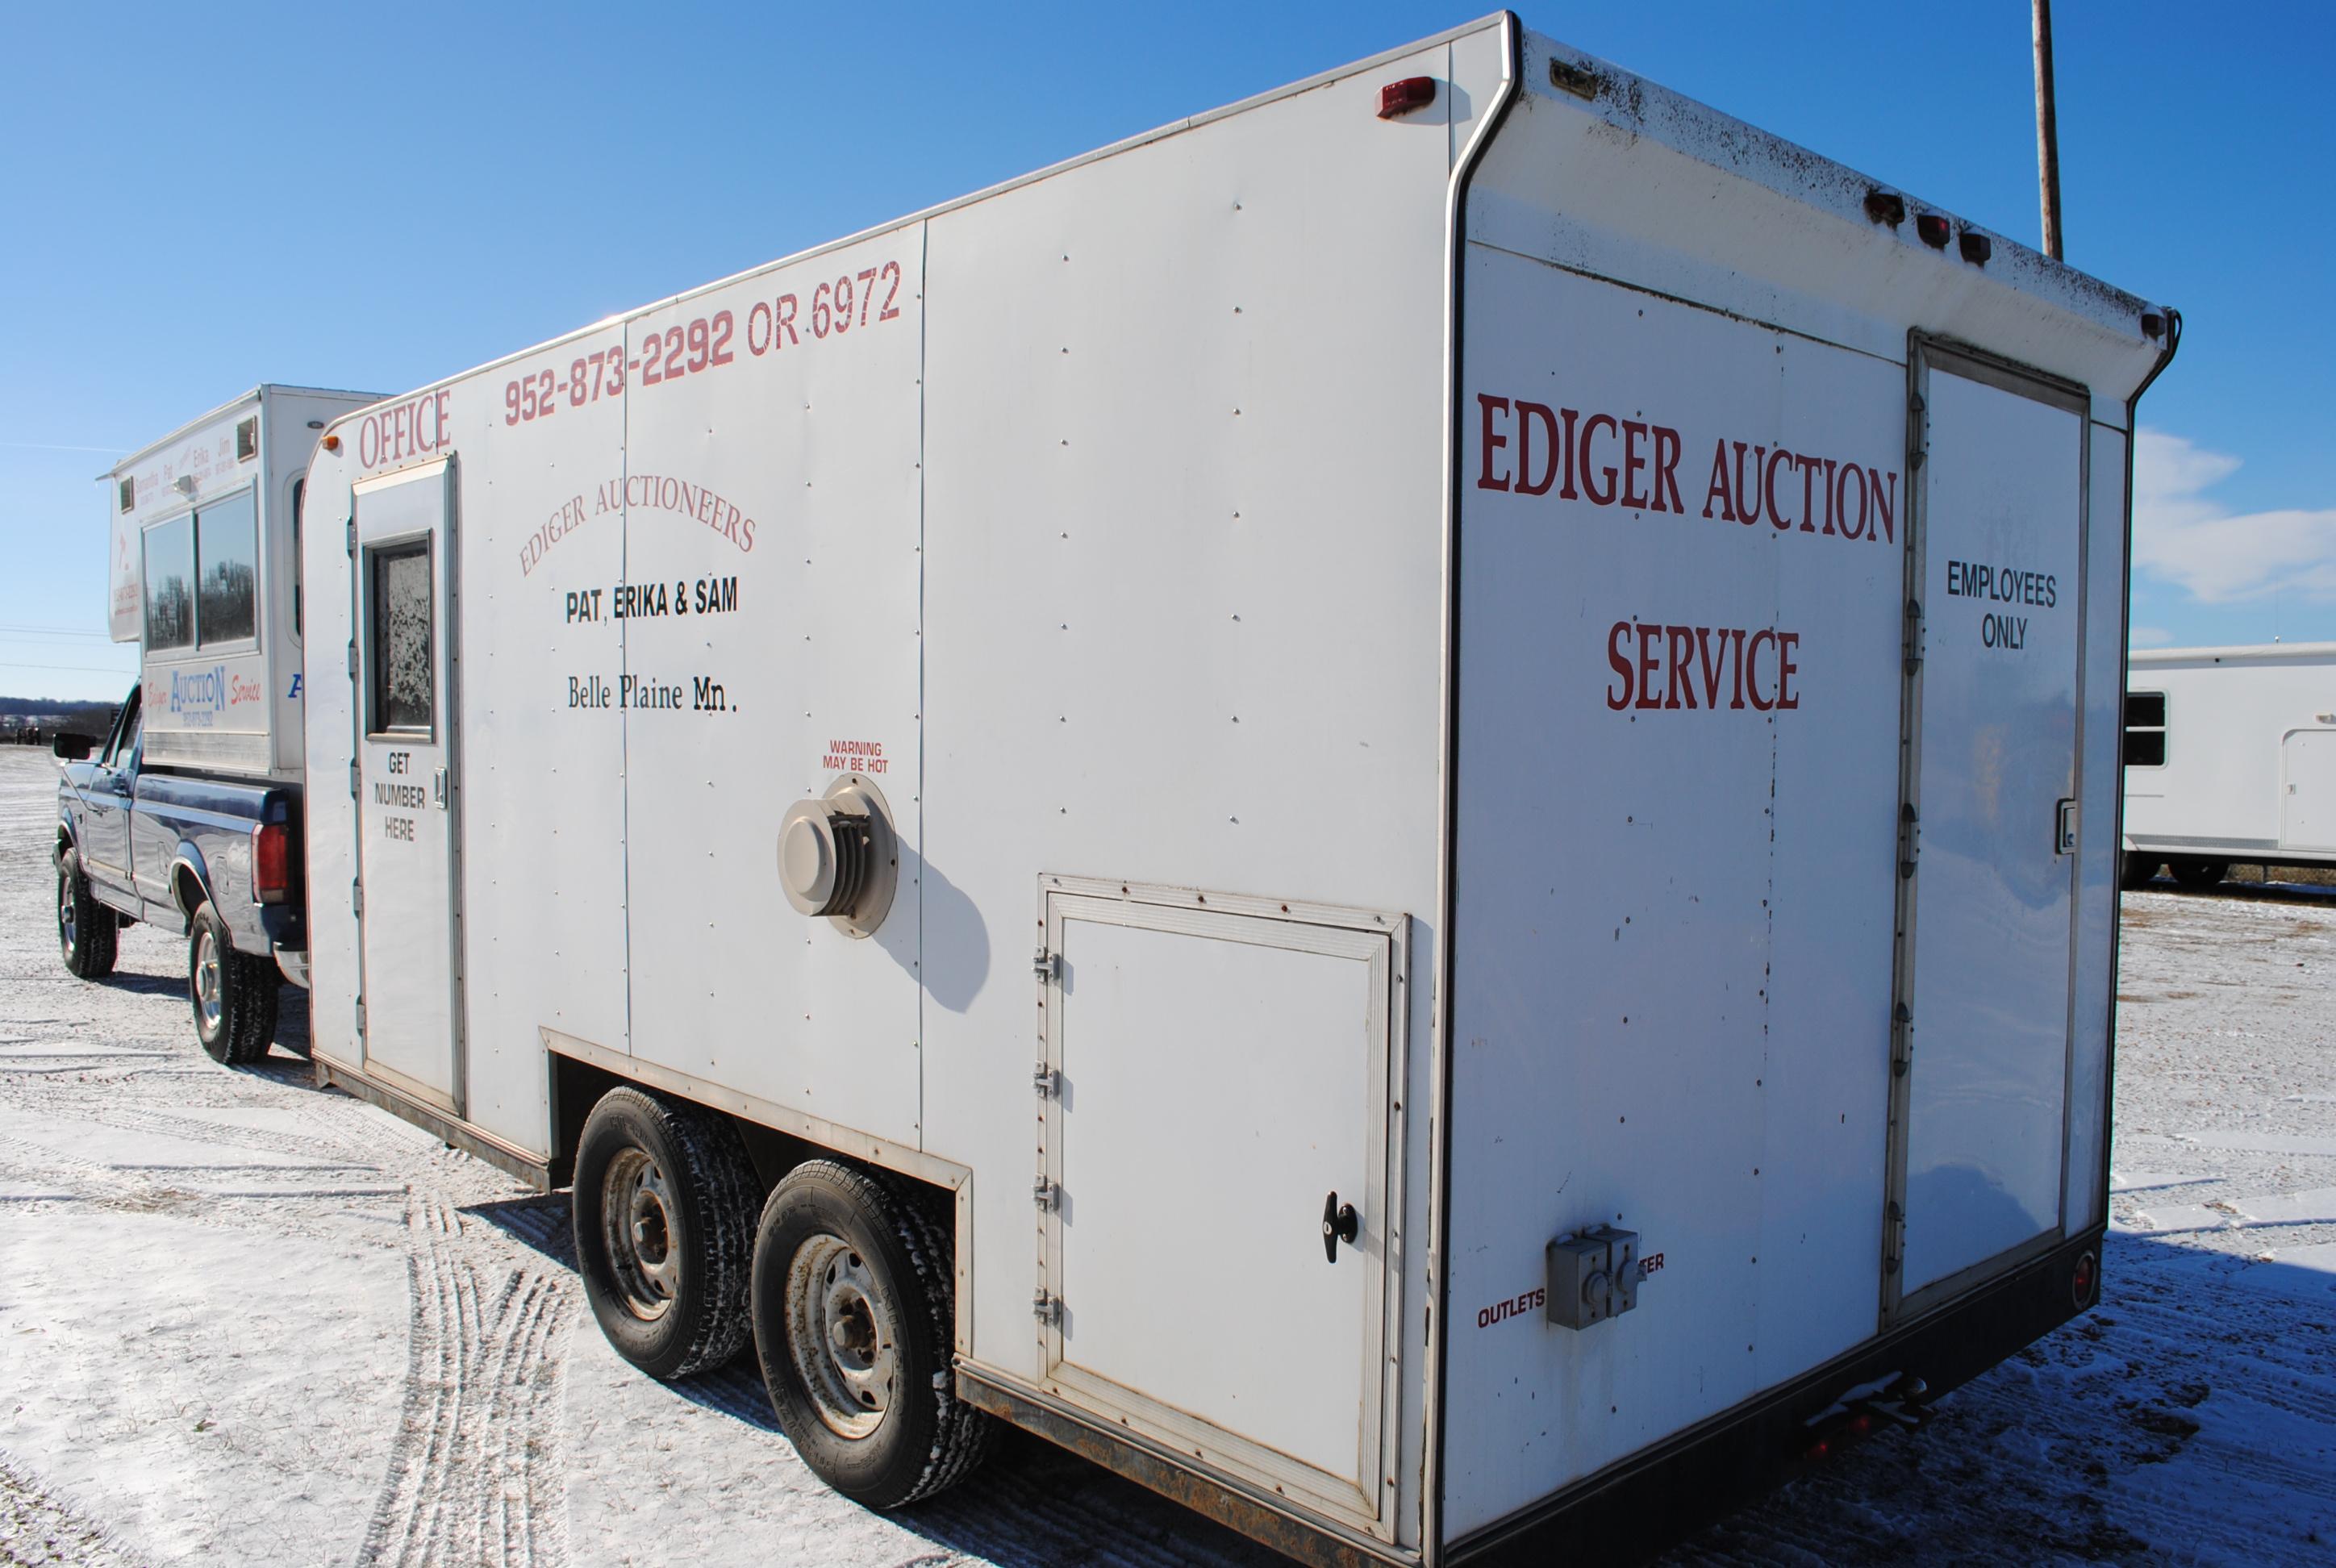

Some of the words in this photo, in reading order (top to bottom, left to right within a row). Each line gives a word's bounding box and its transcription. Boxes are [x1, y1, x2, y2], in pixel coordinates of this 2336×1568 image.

[504, 310, 734, 427] 952-873-2292
[748, 293, 800, 357] OR
[811, 260, 901, 339] 6972
[360, 390, 452, 469] OFFICE
[1477, 393, 1685, 515] EDIGER
[1702, 438, 1897, 544] AUCTION
[519, 494, 586, 578] EDIGER
[595, 475, 757, 553] AUCTIONEERS
[566, 590, 608, 626] PAT,
[614, 584, 669, 619] ERIKA
[675, 581, 688, 615] &
[695, 577, 738, 614] SAM
[1947, 561, 2057, 608] EMPLOYEES
[1982, 613, 2028, 650] ONLY
[1608, 621, 1800, 711] SERVICE
[569, 675, 611, 707] Belle
[619, 674, 683, 710] Plaine
[694, 676, 737, 712] Mn.
[389, 752, 410, 774] GET
[823, 755, 846, 770] MAY
[850, 757, 864, 771] BE
[867, 758, 889, 774] HOT
[830, 740, 882, 757] WARNING
[375, 782, 425, 809] NUMBER
[385, 816, 414, 841] HERE
[1478, 1288, 1546, 1328] OUTLETS
